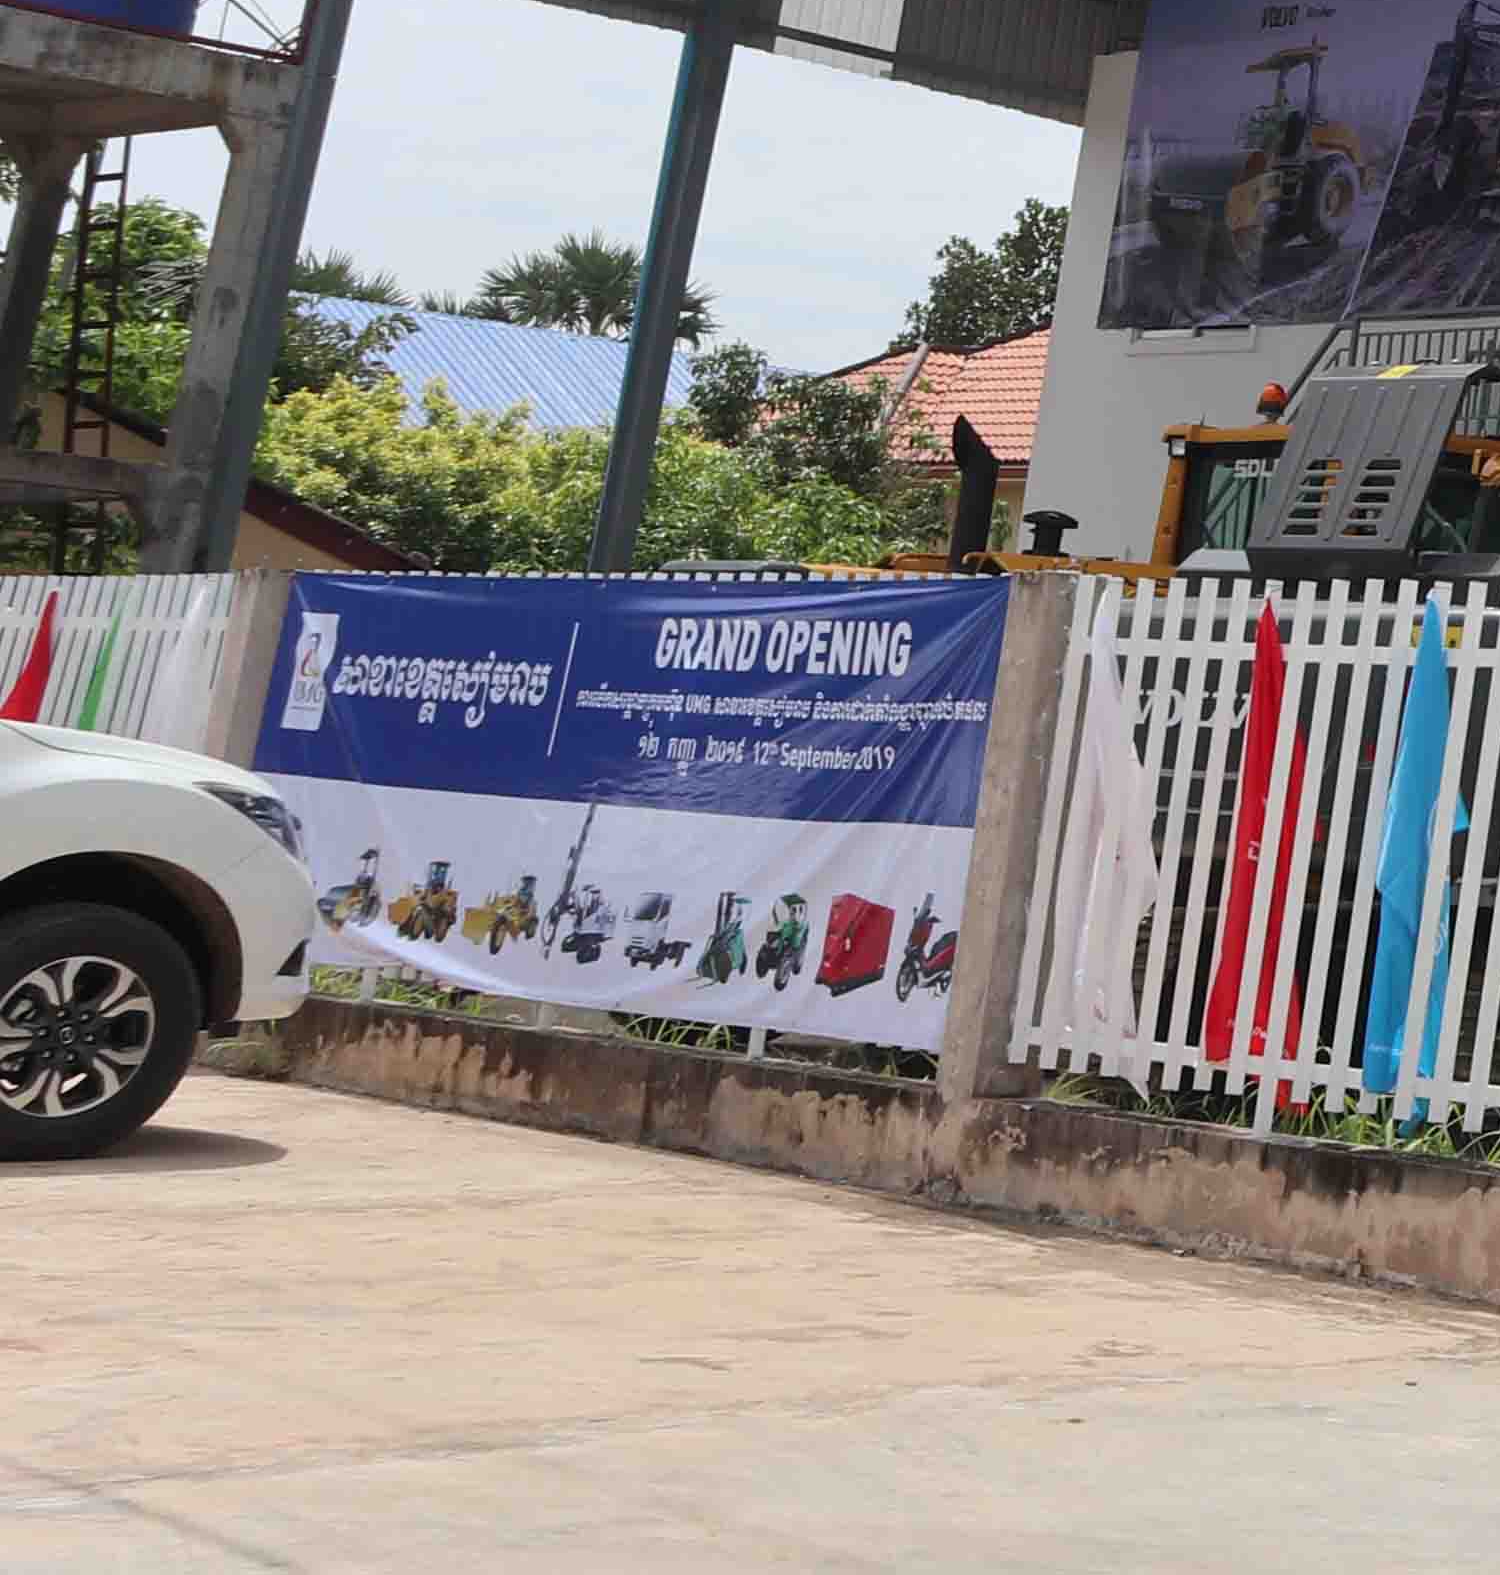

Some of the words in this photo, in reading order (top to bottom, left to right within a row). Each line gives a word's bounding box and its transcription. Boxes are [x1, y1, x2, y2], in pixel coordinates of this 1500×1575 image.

[655, 617, 760, 672] GRAND
[765, 619, 912, 677] OPENING
[685, 694, 712, 714] UMG
